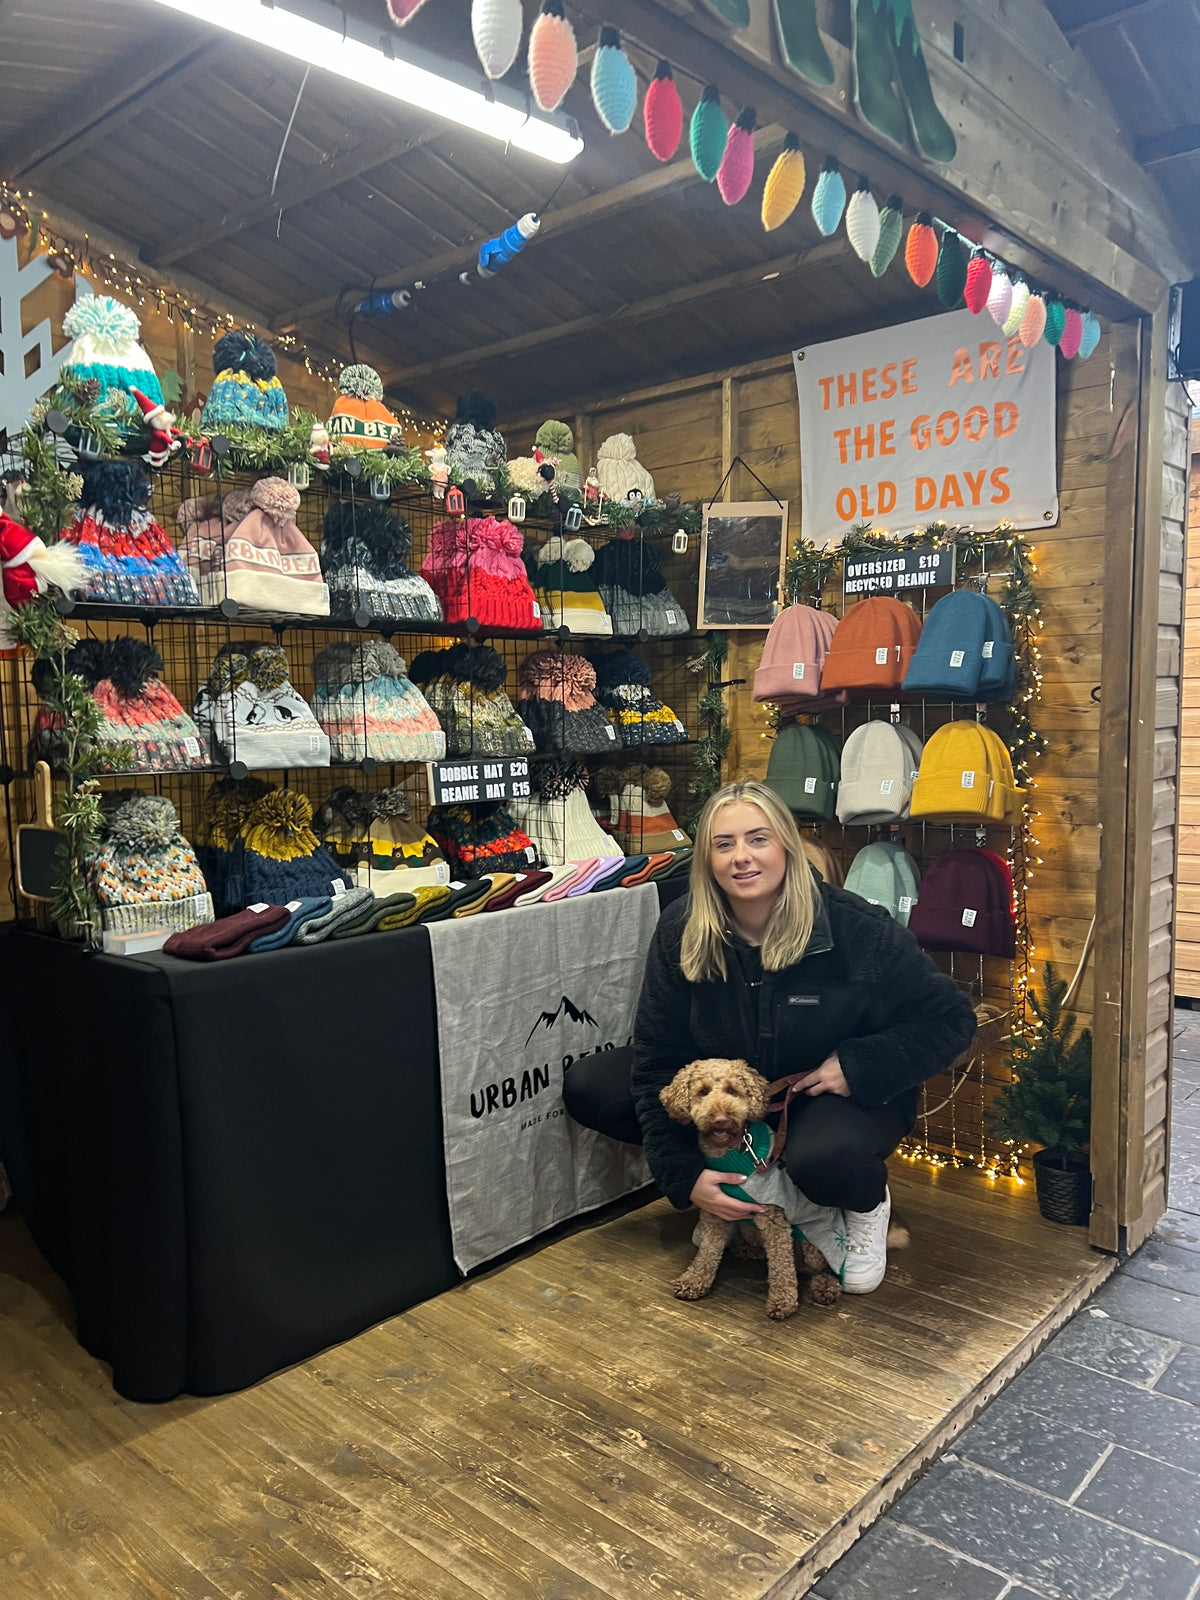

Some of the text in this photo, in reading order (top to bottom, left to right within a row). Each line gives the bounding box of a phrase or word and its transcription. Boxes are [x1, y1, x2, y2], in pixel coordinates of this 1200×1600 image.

[818, 337, 1026, 410] THESE ARE
[364, 422, 402, 439] BEA
[833, 401, 1019, 464] THE GOOD
[836, 467, 1011, 521] OLD DAYS
[847, 554, 940, 577] OVERSIZED £18
[897, 571, 936, 588] BEANIE
[439, 762, 528, 782] BOBBLE HAT £20
[441, 781, 530, 803] BEANIE HAT £15
[470, 1064, 550, 1119] URBAN
